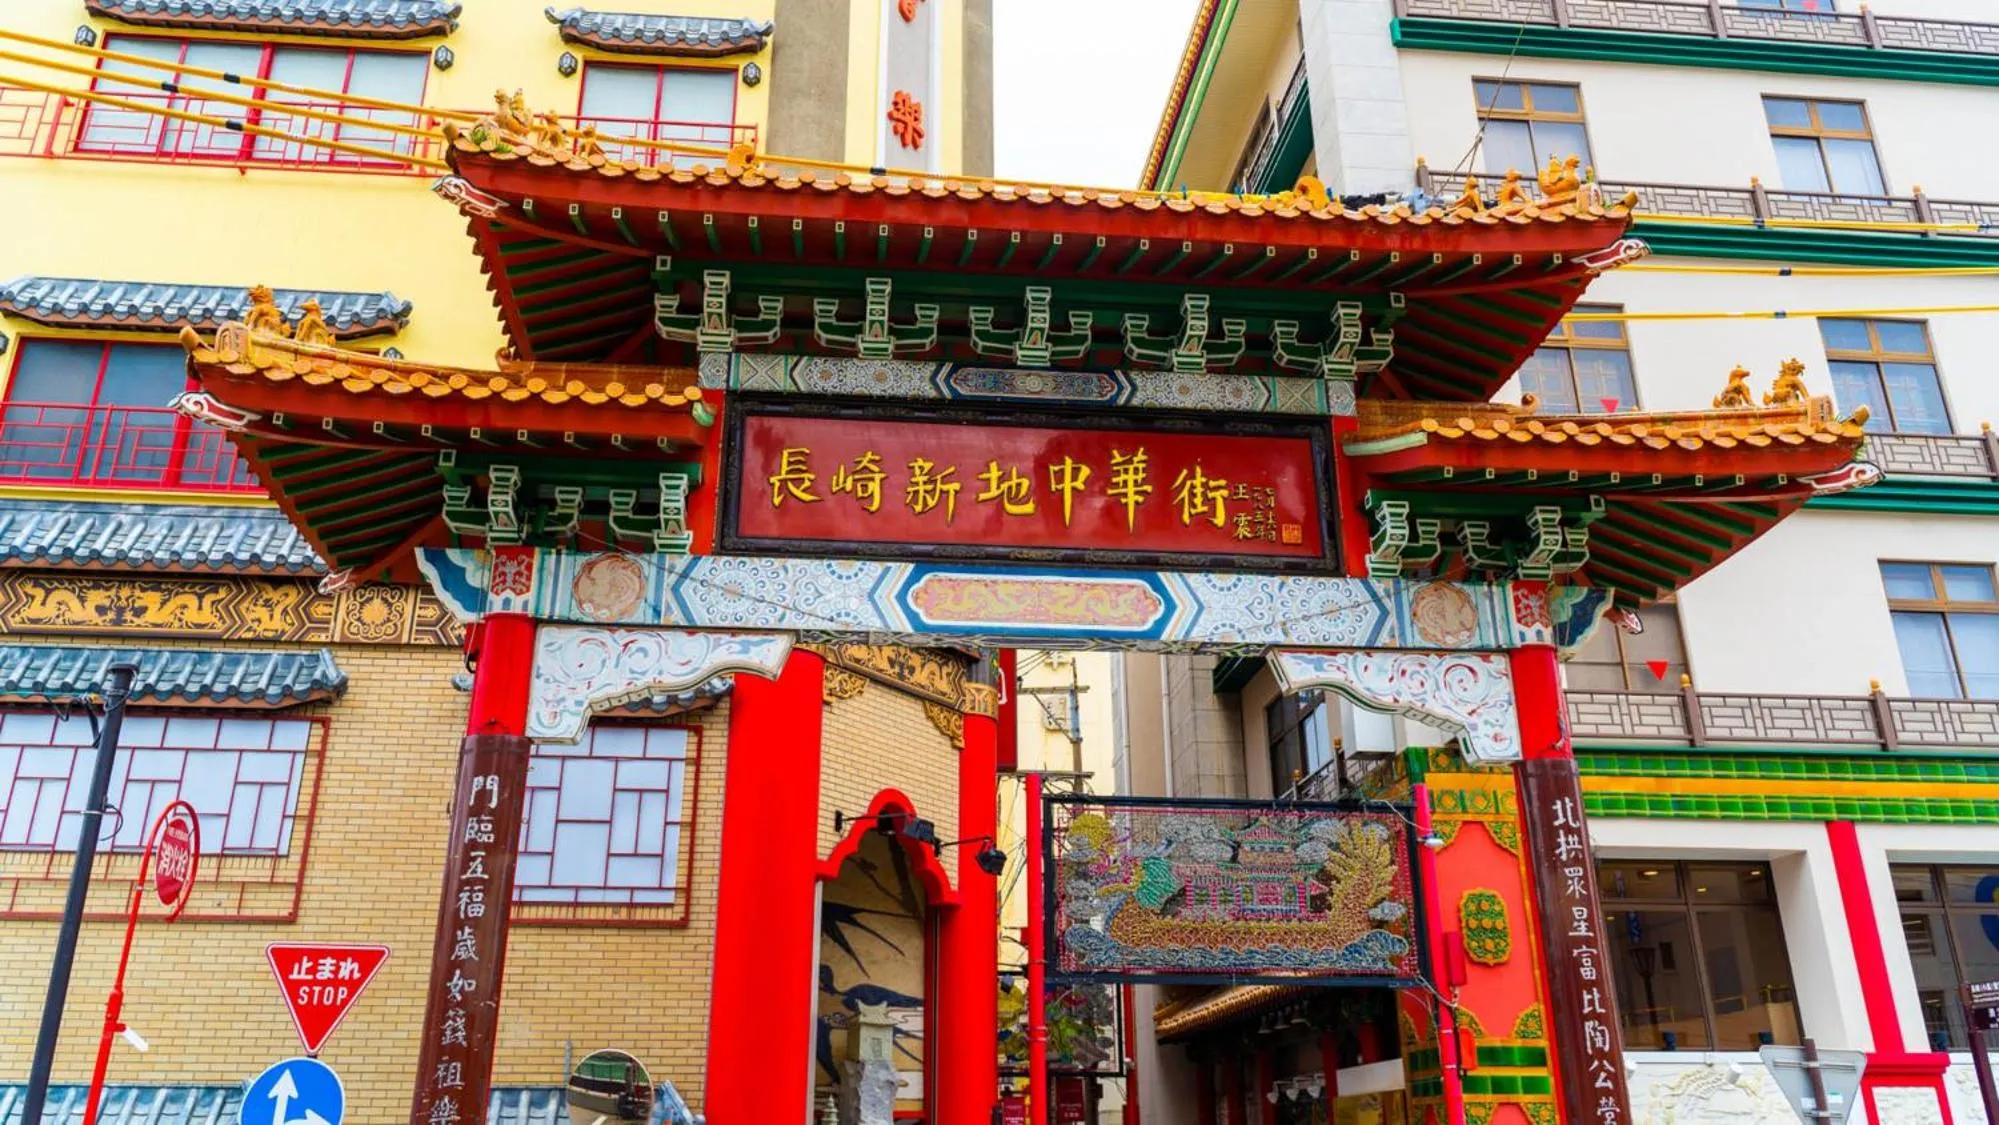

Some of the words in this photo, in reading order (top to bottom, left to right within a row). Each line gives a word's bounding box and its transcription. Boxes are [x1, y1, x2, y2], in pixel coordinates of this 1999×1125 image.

[768, 446, 1230, 535] 長崎新地中華街
[158, 841, 189, 882] 消火栓
[288, 955, 361, 980] 止まれ
[298, 985, 348, 1006] STOP
